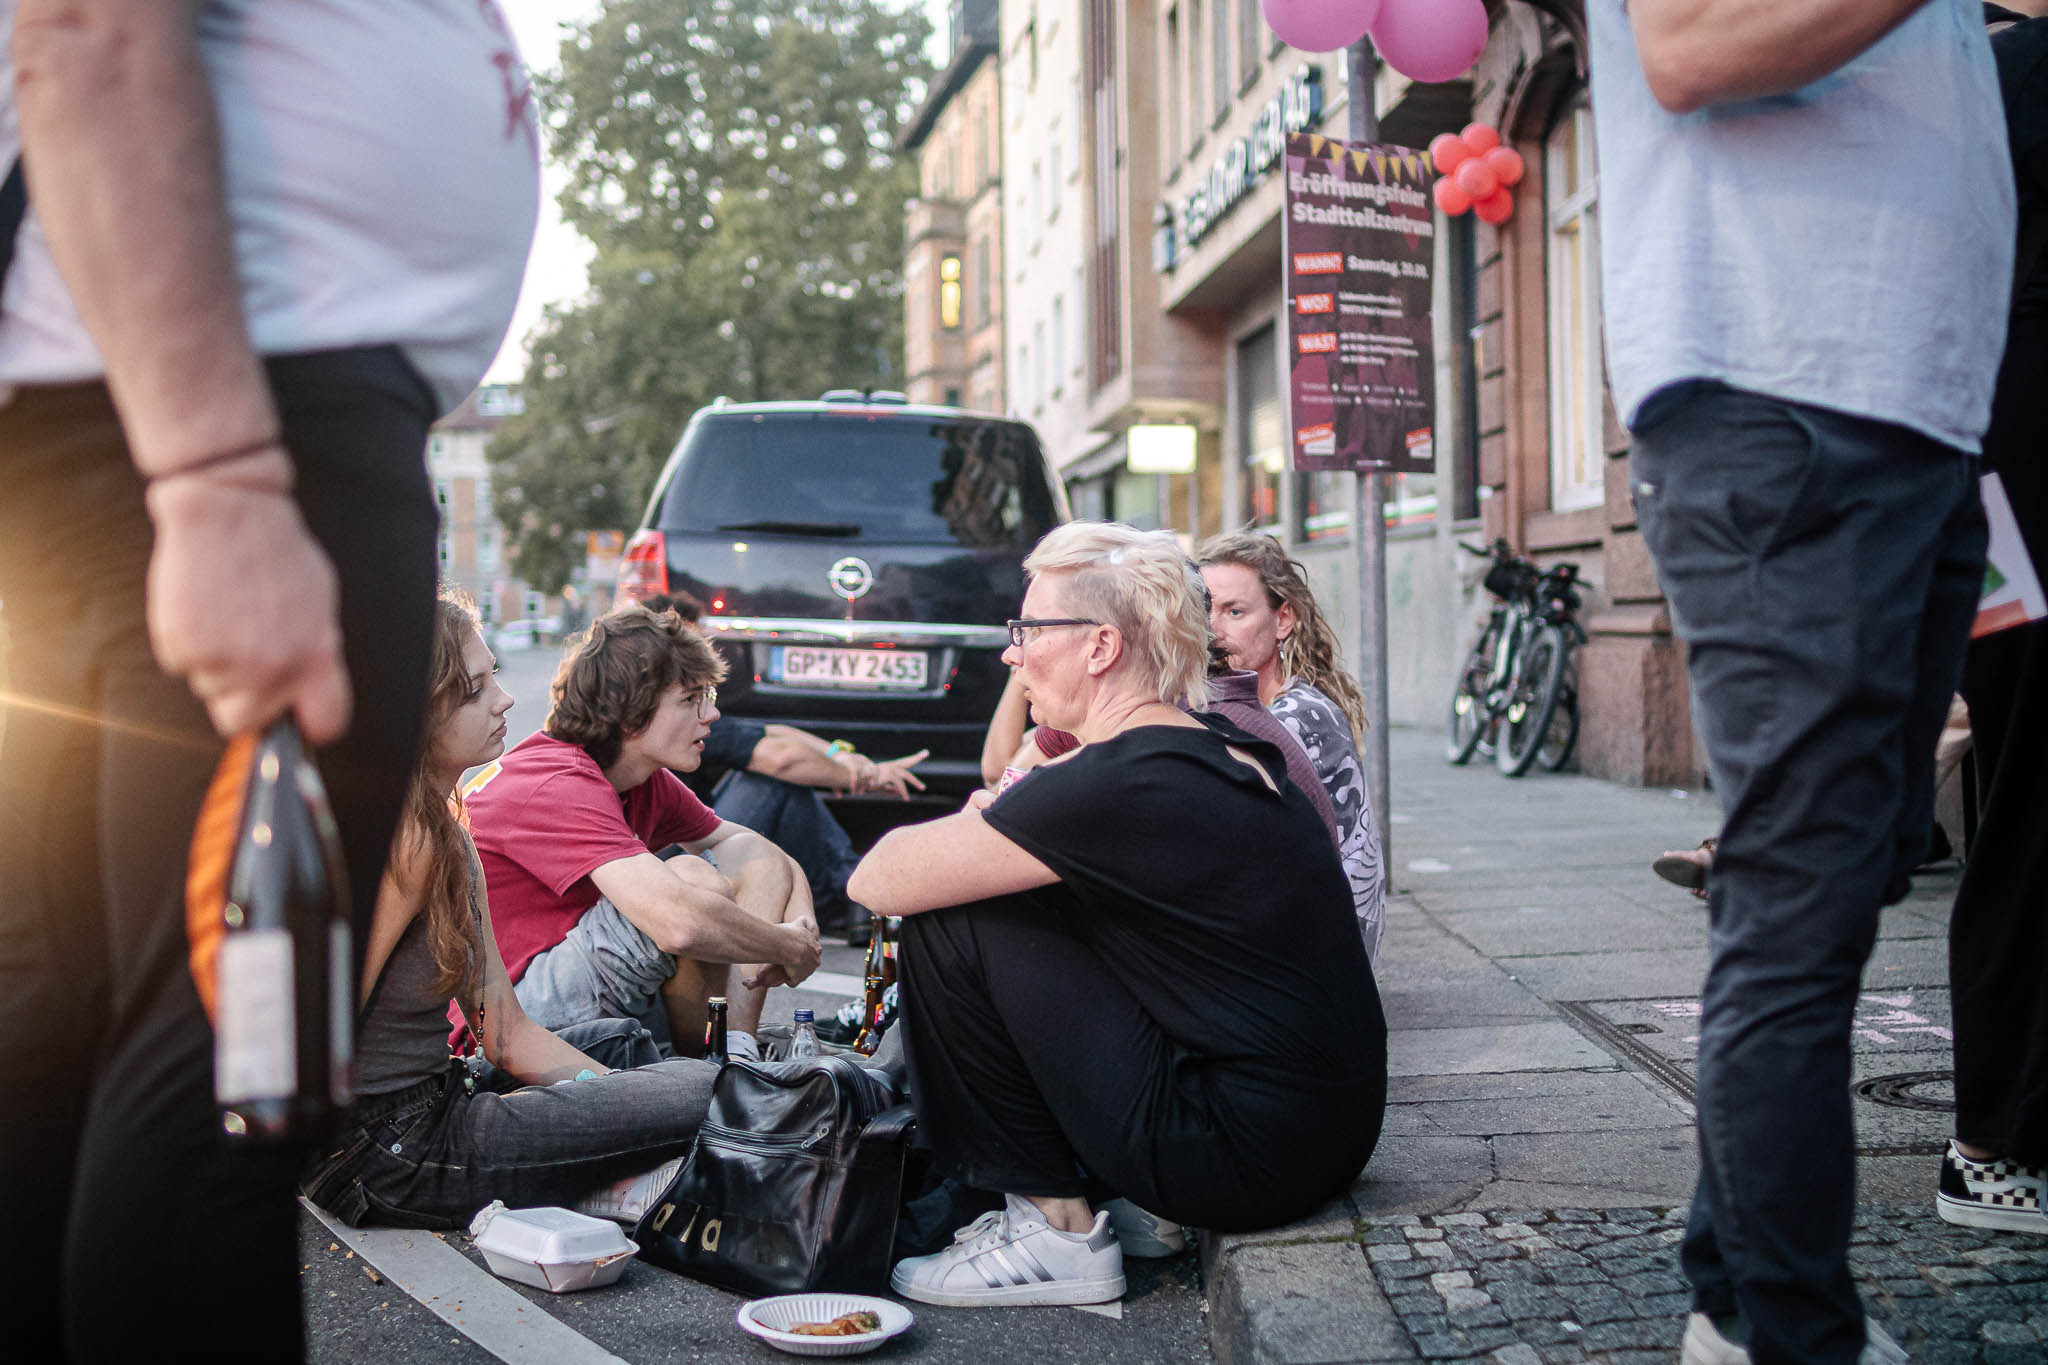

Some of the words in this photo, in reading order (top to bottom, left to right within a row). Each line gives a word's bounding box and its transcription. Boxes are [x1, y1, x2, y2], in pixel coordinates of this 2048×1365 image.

[1292, 202, 1433, 237] Stadtteilzentrum
[1296, 254, 1342, 271] WANN?
[1300, 295, 1330, 311] WO?
[1301, 335, 1336, 350] WAS?
[831, 653, 861, 675] KY
[866, 656, 922, 680] 2453
